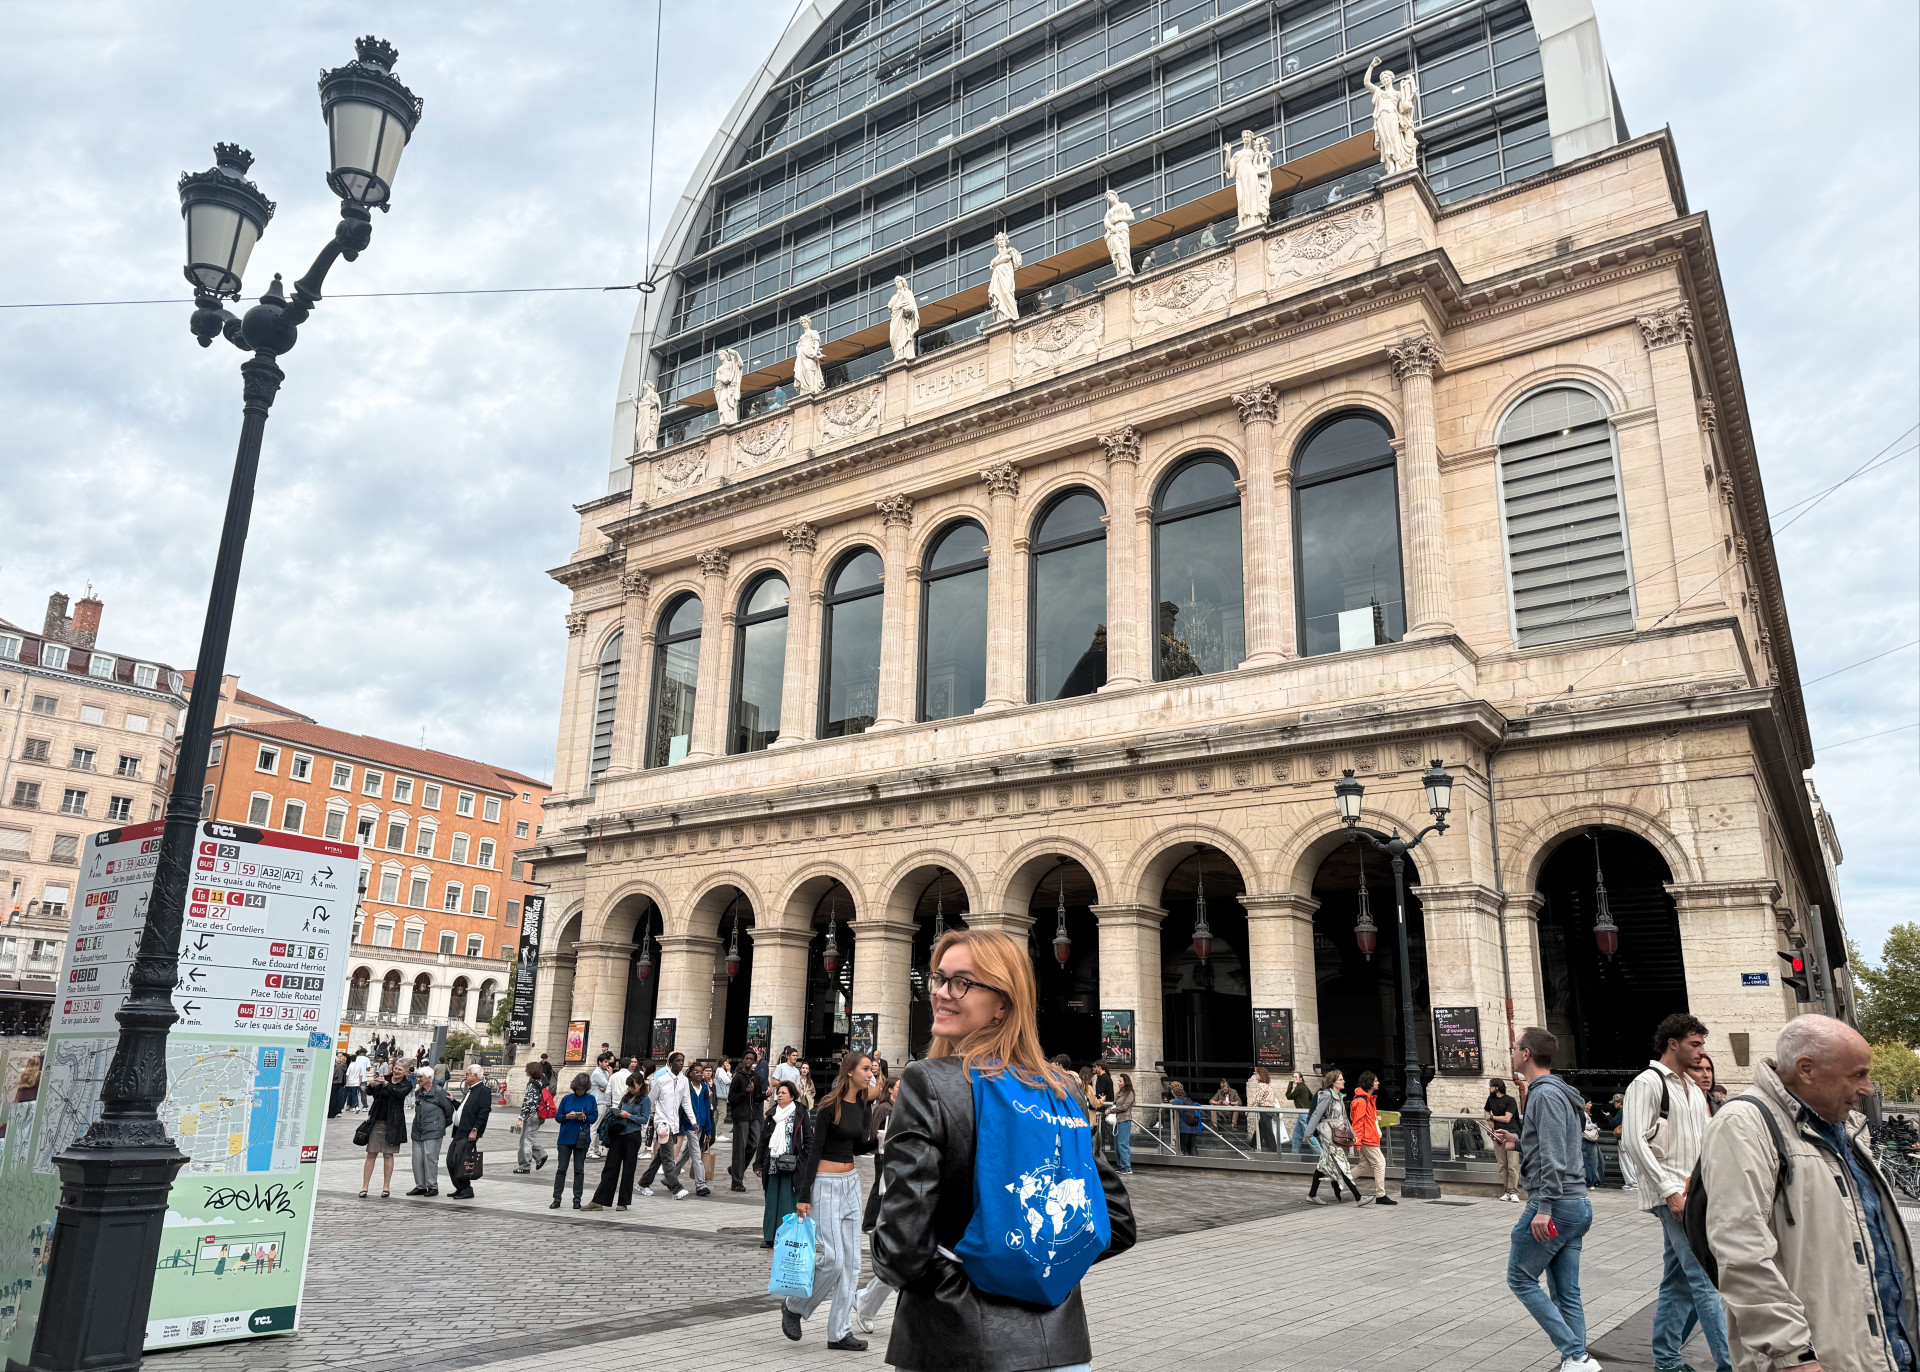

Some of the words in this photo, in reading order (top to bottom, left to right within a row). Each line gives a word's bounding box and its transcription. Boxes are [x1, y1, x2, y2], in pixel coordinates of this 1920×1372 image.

[212, 824, 237, 838] TCL
[151, 840, 160, 851] 23
[204, 844, 214, 854] C
[222, 846, 236, 857] 23
[126, 860, 134, 870] 59
[148, 856, 158, 866] A71
[200, 860, 214, 868] BUS
[223, 862, 230, 872] 9
[242, 864, 256, 875] 59
[262, 868, 280, 878] A32
[284, 872, 300, 881] A71
[194, 872, 208, 881] Sur
[210, 874, 220, 883] les
[224, 876, 243, 886] quais
[246, 879, 256, 888] du
[258, 880, 282, 890] Rhône
[324, 882, 338, 890] min.
[211, 892, 224, 902] 11
[231, 894, 240, 904] C
[248, 896, 262, 906] 14
[106, 906, 114, 917] 27
[192, 906, 206, 914] BUS
[212, 907, 226, 918] 27
[186, 919, 208, 928] Place
[210, 922, 224, 930] des
[226, 923, 264, 934] Cordeliers
[198, 954, 213, 962] min.
[252, 958, 266, 966] Rue
[268, 958, 298, 969] Édouard
[300, 962, 326, 972] Herriot
[186, 984, 190, 992] 6
[270, 976, 278, 986] C
[286, 978, 299, 988] 13
[307, 978, 320, 989] 18
[250, 988, 270, 998] Place
[274, 990, 292, 1000] Tobie
[294, 992, 322, 1002] Robatel
[72, 1002, 80, 1012] 19
[82, 1001, 90, 1012] 31
[260, 1006, 273, 1017] 19
[281, 1008, 294, 1018] 31
[302, 1009, 316, 1020] 40
[187, 1018, 202, 1026] min.
[234, 1020, 248, 1028] Sur
[250, 1020, 260, 1028] les
[262, 1022, 282, 1031] quais
[284, 1022, 294, 1030] de
[296, 1022, 318, 1032] Saône
[302, 1150, 318, 1158] CNT
[254, 1316, 272, 1326] TCL
